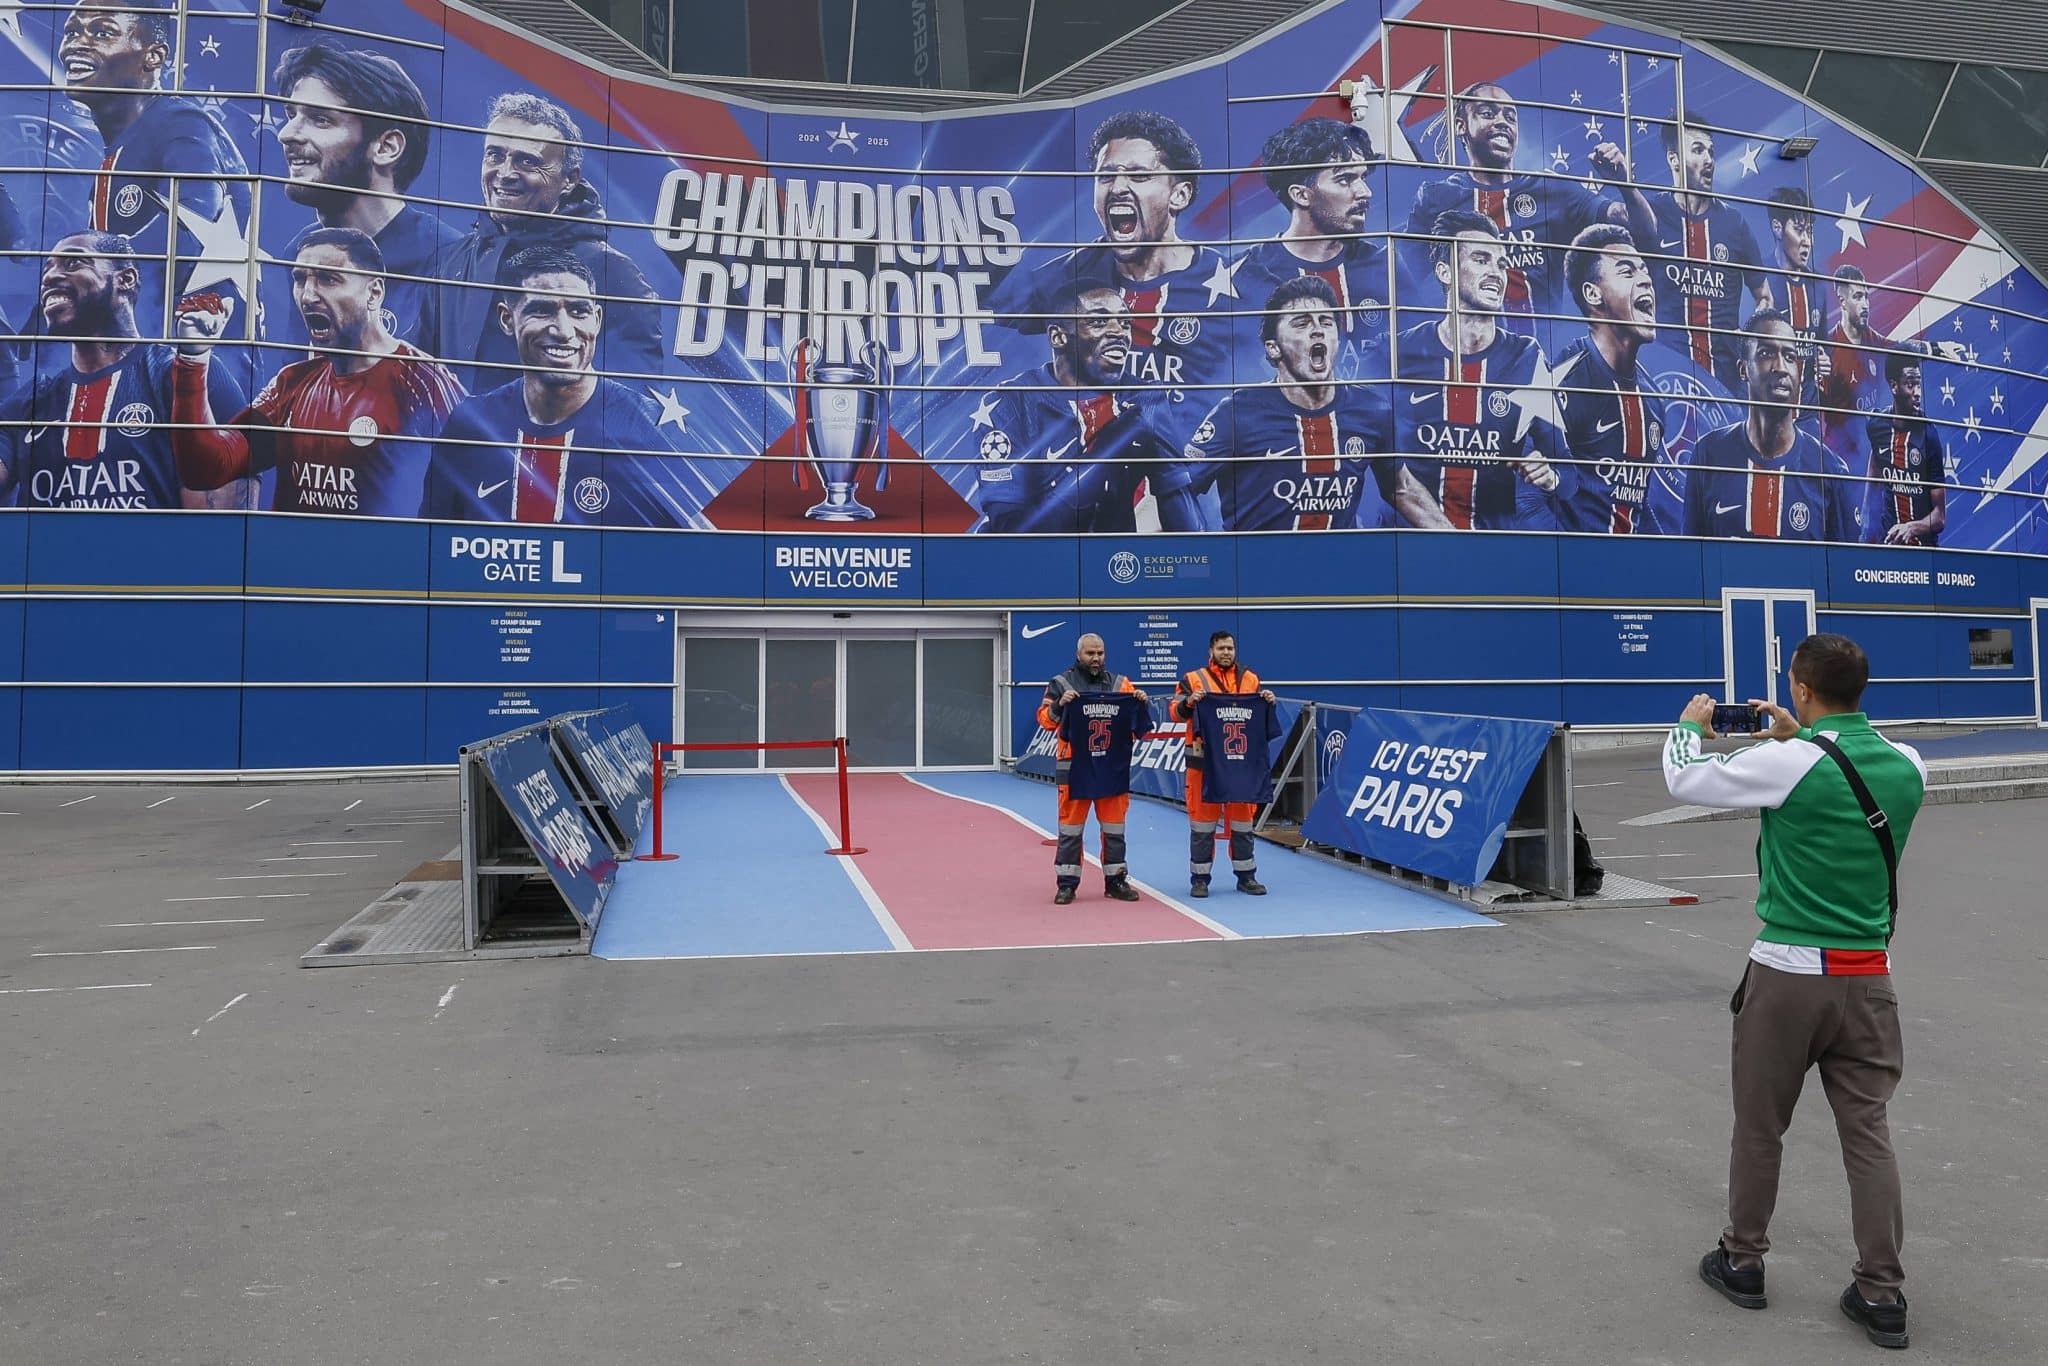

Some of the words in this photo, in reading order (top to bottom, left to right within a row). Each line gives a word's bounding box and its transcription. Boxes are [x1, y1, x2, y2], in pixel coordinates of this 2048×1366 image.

[798, 134, 820, 143] 2024
[867, 137, 889, 146] 2025
[653, 168, 1023, 267] CHAMPIONS
[1506, 251, 1545, 269] WAYS
[1665, 264, 1725, 288] QATAR
[1680, 283, 1725, 298] AIRWAYS
[673, 259, 1002, 367] D'EUROPE
[1127, 350, 1185, 384] TAR
[1417, 424, 1501, 451] QATAR
[1439, 448, 1500, 465] AIRWAYS
[32, 459, 146, 506] QATAR
[1882, 467, 1921, 485] QATAR
[1273, 476, 1358, 504] QATAR
[1892, 483, 1923, 495] AIRWAYS
[451, 536, 541, 561] PORTE
[551, 540, 582, 583] L
[776, 547, 911, 568] BIENVENUE
[1143, 555, 1209, 564] EXECUTIVE
[484, 563, 541, 582] GATE
[790, 570, 898, 588] WELCOME
[1144, 565, 1174, 574] CLUB
[1854, 569, 1930, 584] CONCIERGERIE
[1937, 572, 1950, 585] DU
[1951, 573, 1976, 587] PARC
[1082, 703, 1120, 718] CHAMPIONS
[1216, 707, 1253, 720] CHAMPIONS
[1088, 719, 1112, 752] 25
[1223, 722, 1248, 755] 25
[1327, 734, 1344, 752] PARI
[1370, 739, 1407, 773] ICI
[1406, 744, 1487, 784] C'EST
[1346, 775, 1463, 839] PARIS
[543, 807, 592, 878] PARIS
